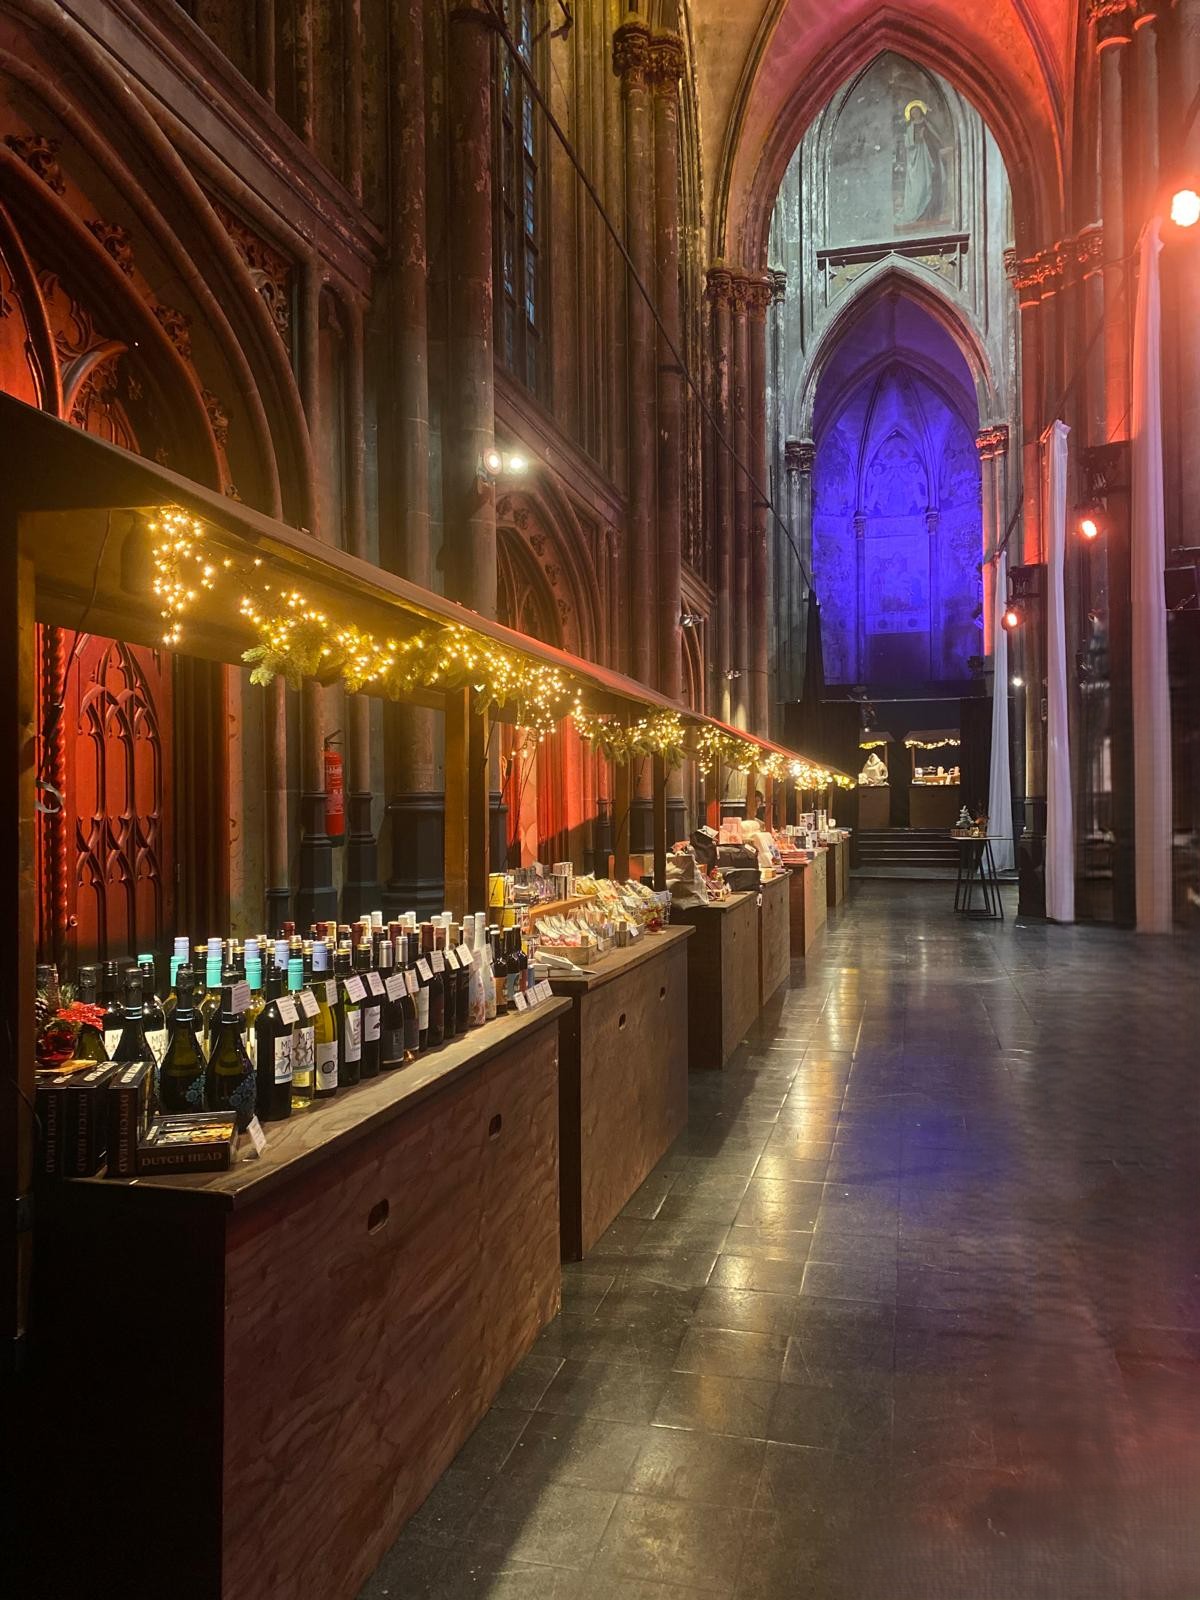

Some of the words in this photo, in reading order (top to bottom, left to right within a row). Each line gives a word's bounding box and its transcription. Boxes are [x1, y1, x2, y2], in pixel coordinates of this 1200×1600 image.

[48, 1094, 57, 1136] DUTCH
[79, 1093, 88, 1135] DUTCH
[119, 1094, 129, 1135] DUTCH
[46, 1139, 56, 1174] HEAD
[119, 1139, 129, 1173] HEAD
[141, 1154, 185, 1167] DUTCH
[187, 1151, 223, 1163] HEAD
